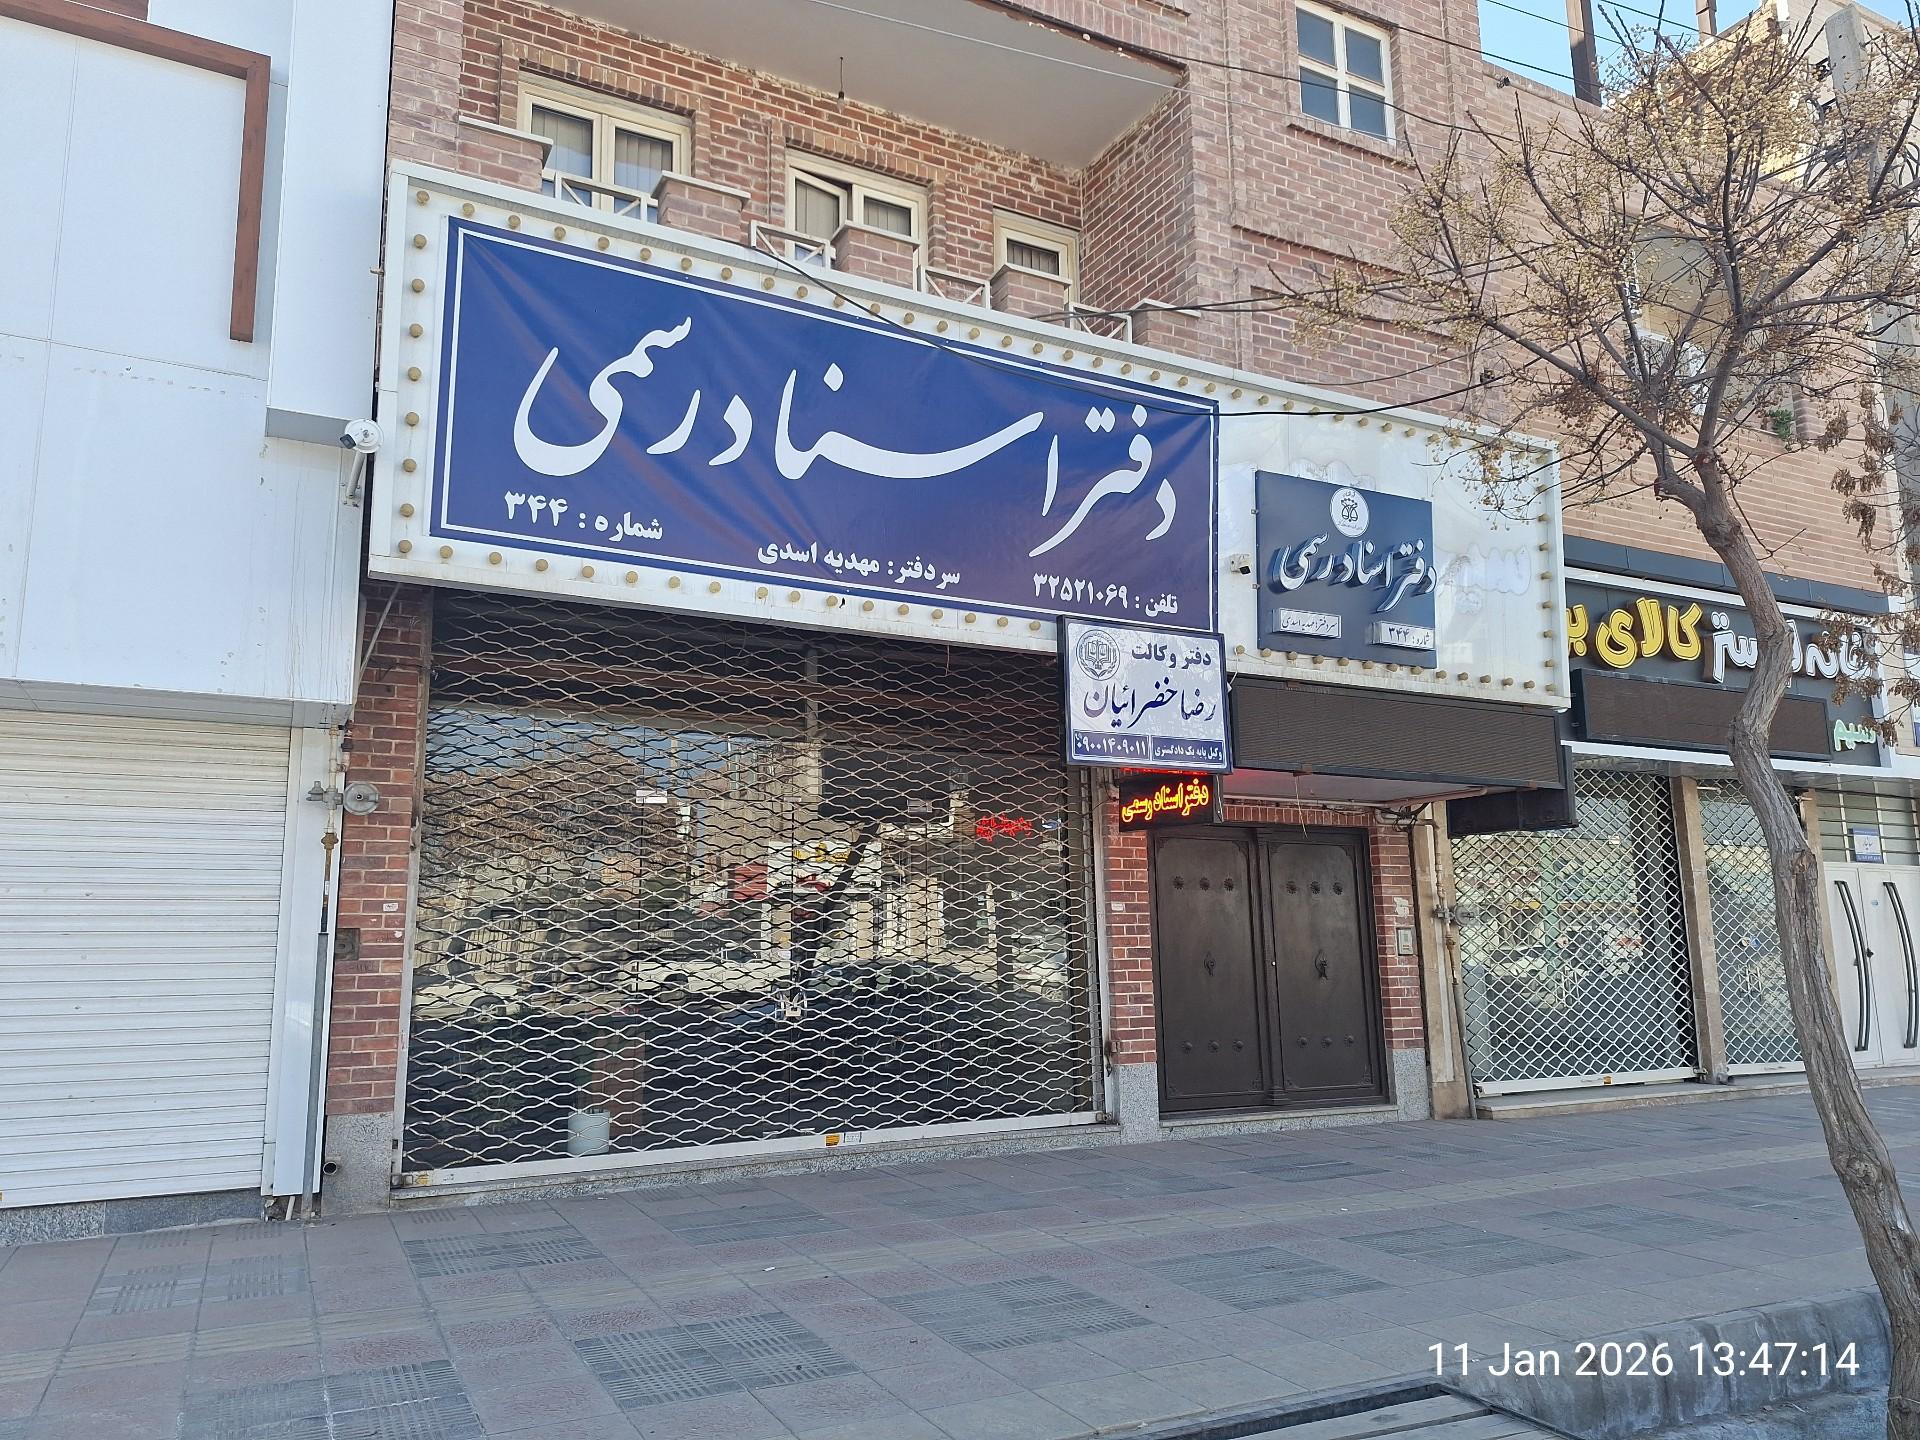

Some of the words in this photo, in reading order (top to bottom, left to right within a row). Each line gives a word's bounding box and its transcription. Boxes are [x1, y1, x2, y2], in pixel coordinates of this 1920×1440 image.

[512, 315, 701, 477] رسمی
[708, 362, 1060, 518] اسناد
[1028, 402, 1177, 557] دفتر
[503, 490, 569, 527] ۳۴۴
[757, 542, 818, 564] اسدی
[823, 549, 880, 576] مهدیه
[1279, 532, 1334, 590] رسمی
[1341, 540, 1393, 588] اسناد
[1378, 539, 1437, 612] دفتر
[1033, 573, 1128, 609] ۳۲۵۲۱۰۶۹
[1388, 626, 1410, 643] ۳۴۴
[1595, 597, 1703, 669] کالای
[1131, 643, 1177, 668] وکالت
[1181, 646, 1212, 669] دفتر
[1180, 688, 1216, 721] رضا
[1076, 735, 1146, 756] ۰۹۰۰۱۴۰۹۰۱۱
[1154, 744, 1184, 757] دادگستری
[1185, 745, 1195, 758] یک
[1196, 746, 1207, 760] پایه
[1207, 746, 1223, 761] وکیل
[1122, 798, 1153, 822] رسمی
[1153, 782, 1183, 811] اسناد
[1181, 778, 1209, 816] دفتر
